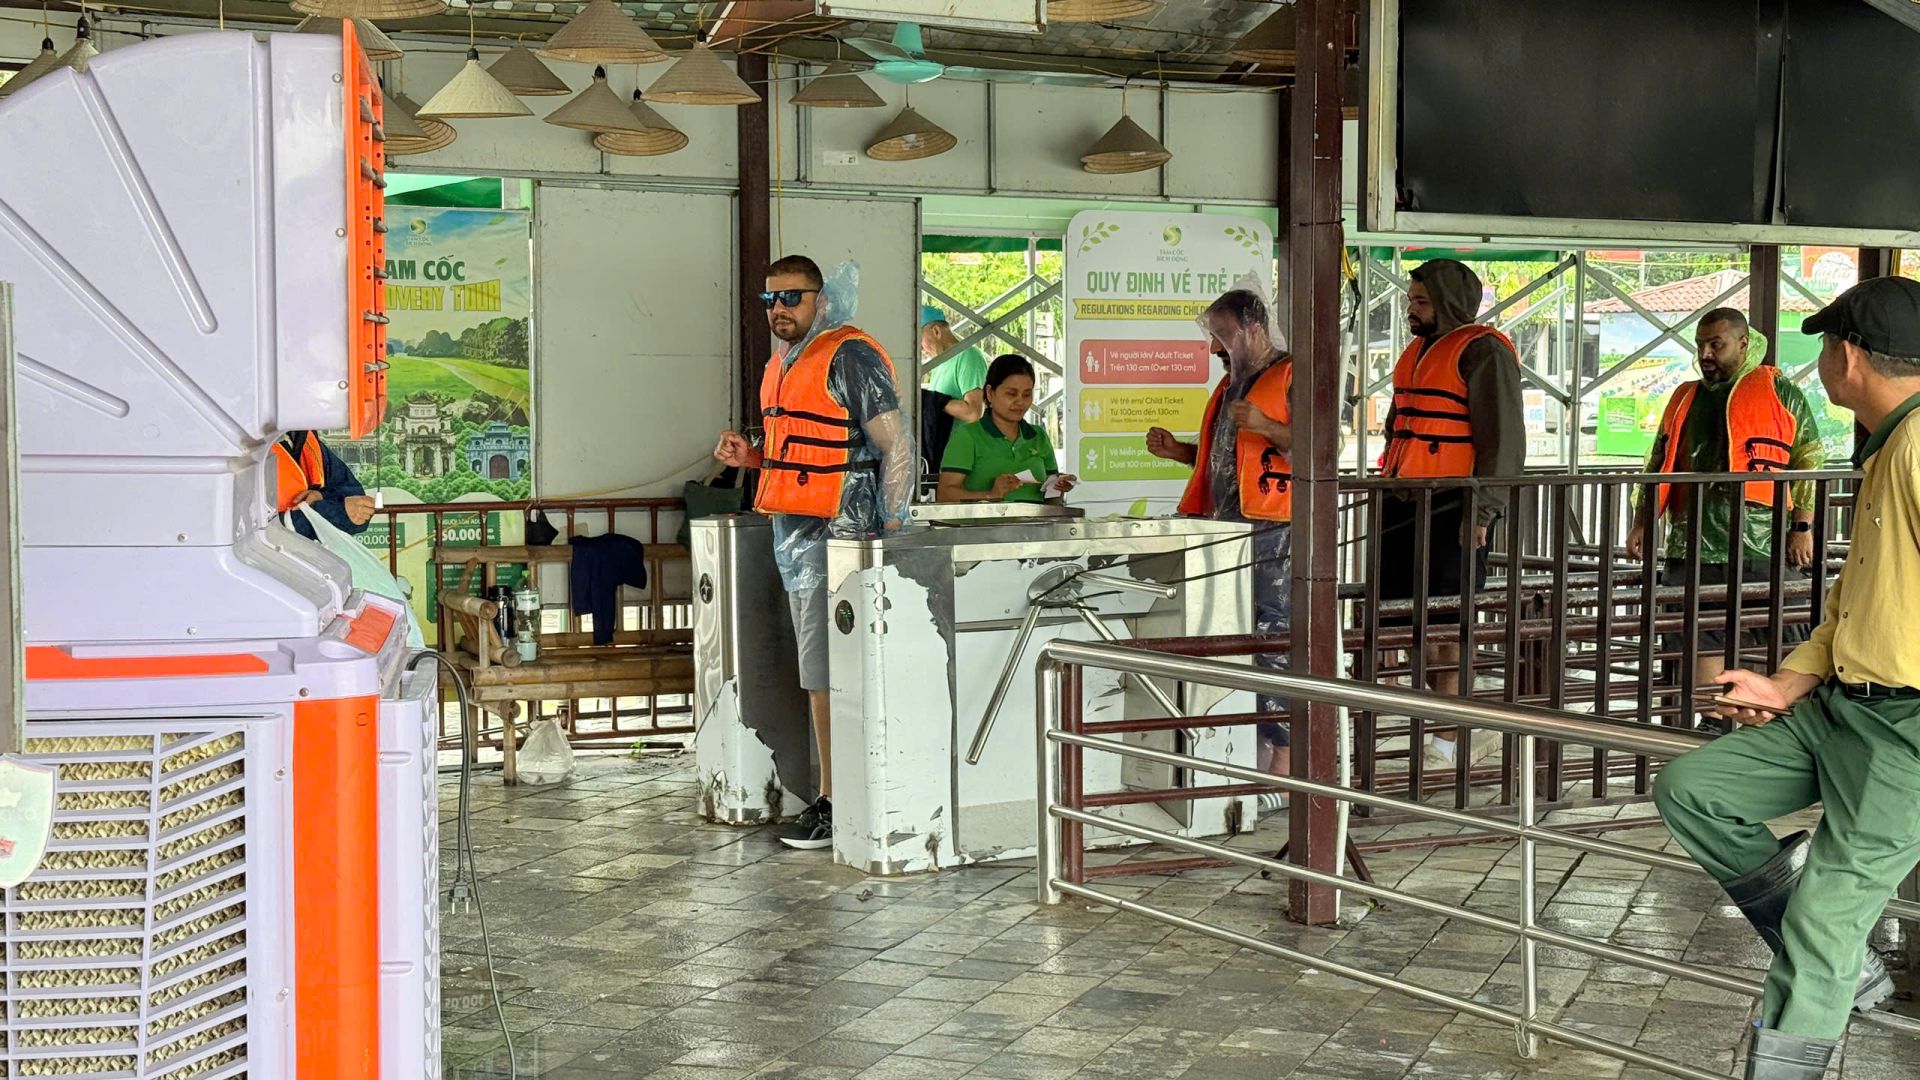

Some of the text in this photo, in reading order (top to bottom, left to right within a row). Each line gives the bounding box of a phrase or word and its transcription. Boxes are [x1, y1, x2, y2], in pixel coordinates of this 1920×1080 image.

[385, 254, 465, 281] AM CỐC
[1087, 271, 1121, 293] QUY
[1126, 272, 1164, 298] ĐỊNH
[1171, 268, 1191, 294] VÉ
[1197, 267, 1227, 294] TRẺ
[385, 279, 501, 312] OVERY TOUR
[1081, 304, 1207, 316] REGULATIONS REGARDING CHILD
[1110, 351, 1119, 359] Vé
[1155, 351, 1173, 359] Adult
[1174, 351, 1194, 360] Ticket
[1110, 363, 1125, 372] Trên
[1126, 364, 1138, 372] 130
[1151, 363, 1170, 373] (Over
[1171, 364, 1183, 372] 130
[1183, 364, 1197, 373] cm)
[1164, 397, 1184, 405] Ticket
[433, 528, 483, 542] 50.000
